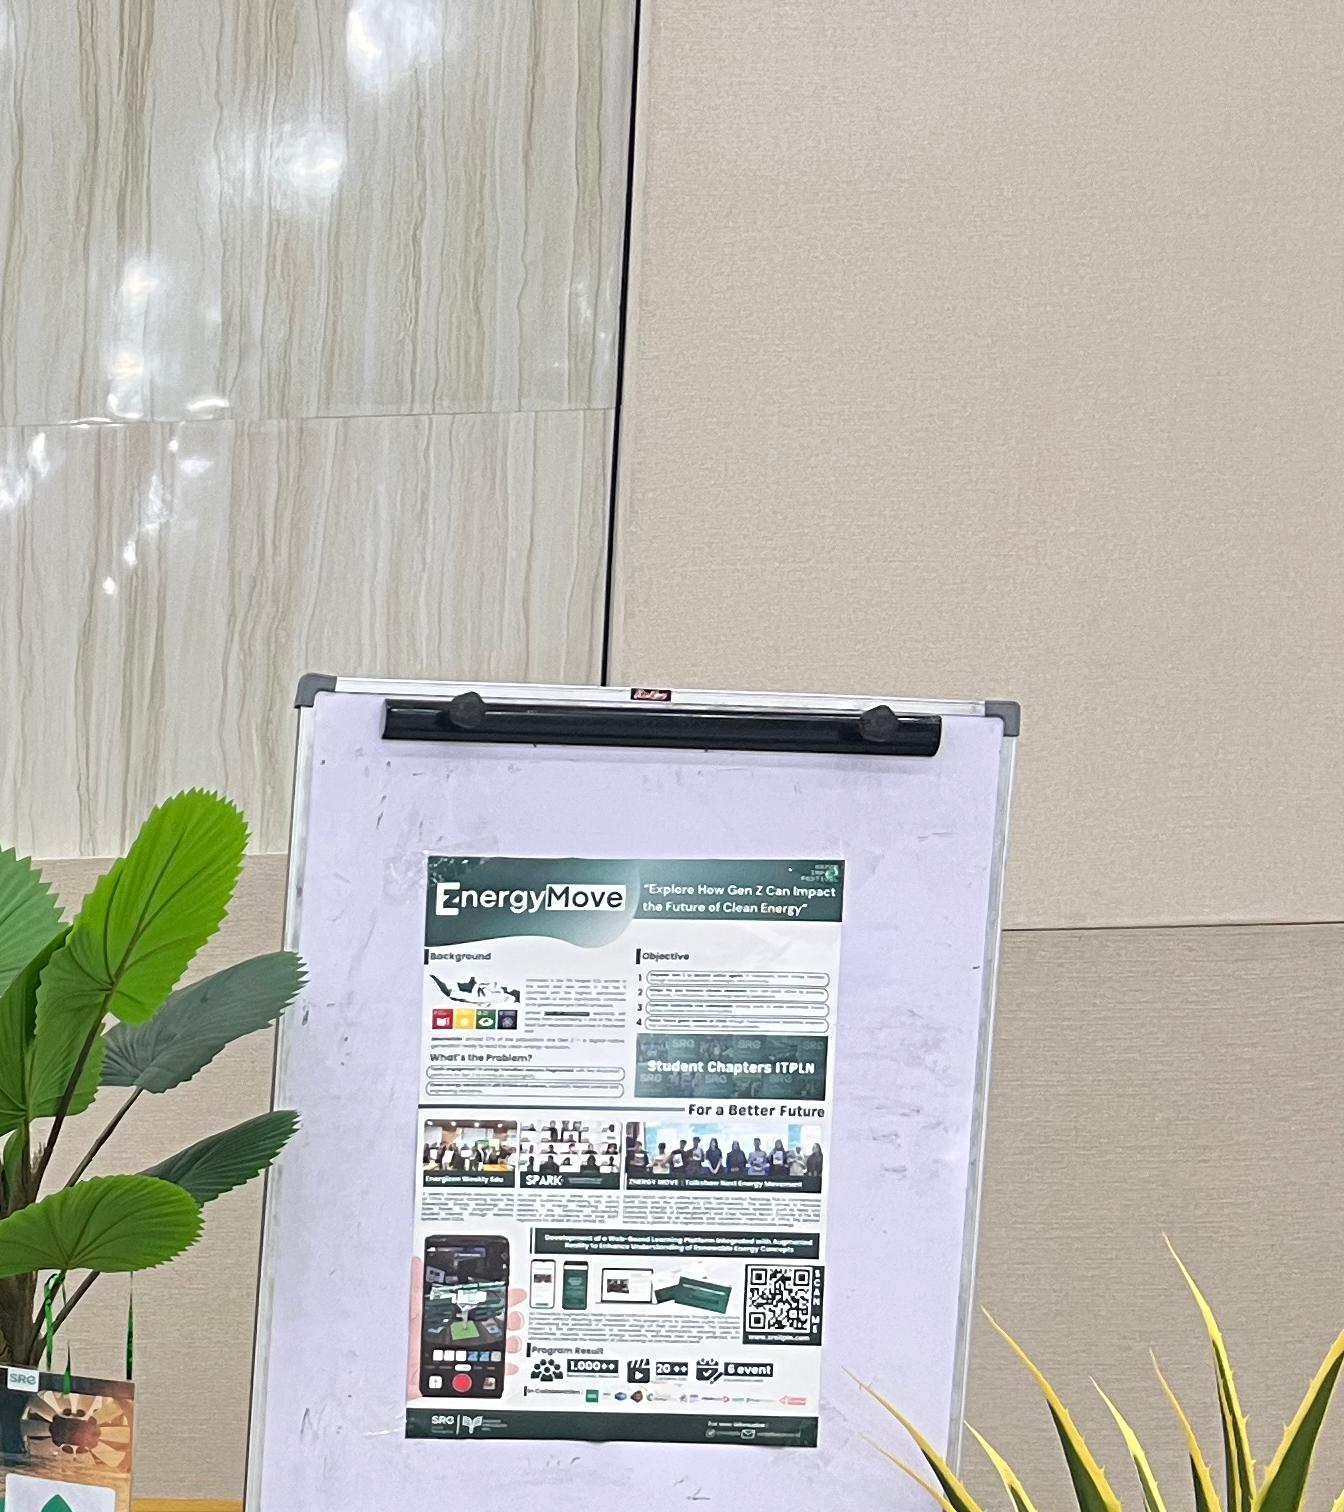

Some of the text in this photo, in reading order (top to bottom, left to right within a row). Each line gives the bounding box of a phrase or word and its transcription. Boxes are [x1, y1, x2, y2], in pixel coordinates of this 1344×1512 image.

[697, 884, 724, 895] How
[727, 884, 753, 896] Gen
[755, 885, 763, 896] Z
[765, 885, 790, 897] Can
[793, 886, 836, 899] Impact
[642, 901, 662, 912] the
[665, 901, 706, 912] Future
[708, 902, 721, 912] of
[722, 902, 758, 913] Clean
[430, 951, 492, 963] Background
[642, 951, 690, 963] Objective
[637, 988, 643, 996] 2
[637, 1003, 643, 1011] 3
[635, 1018, 642, 1026] 4
[468, 1053, 484, 1062] the
[486, 1053, 532, 1063] Problem?
[647, 1060, 815, 1076] Student Chapters ITPLN
[688, 1104, 825, 1118] For a Better Future
[532, 1346, 604, 1356] Program Result
[736, 1366, 772, 1375] event
